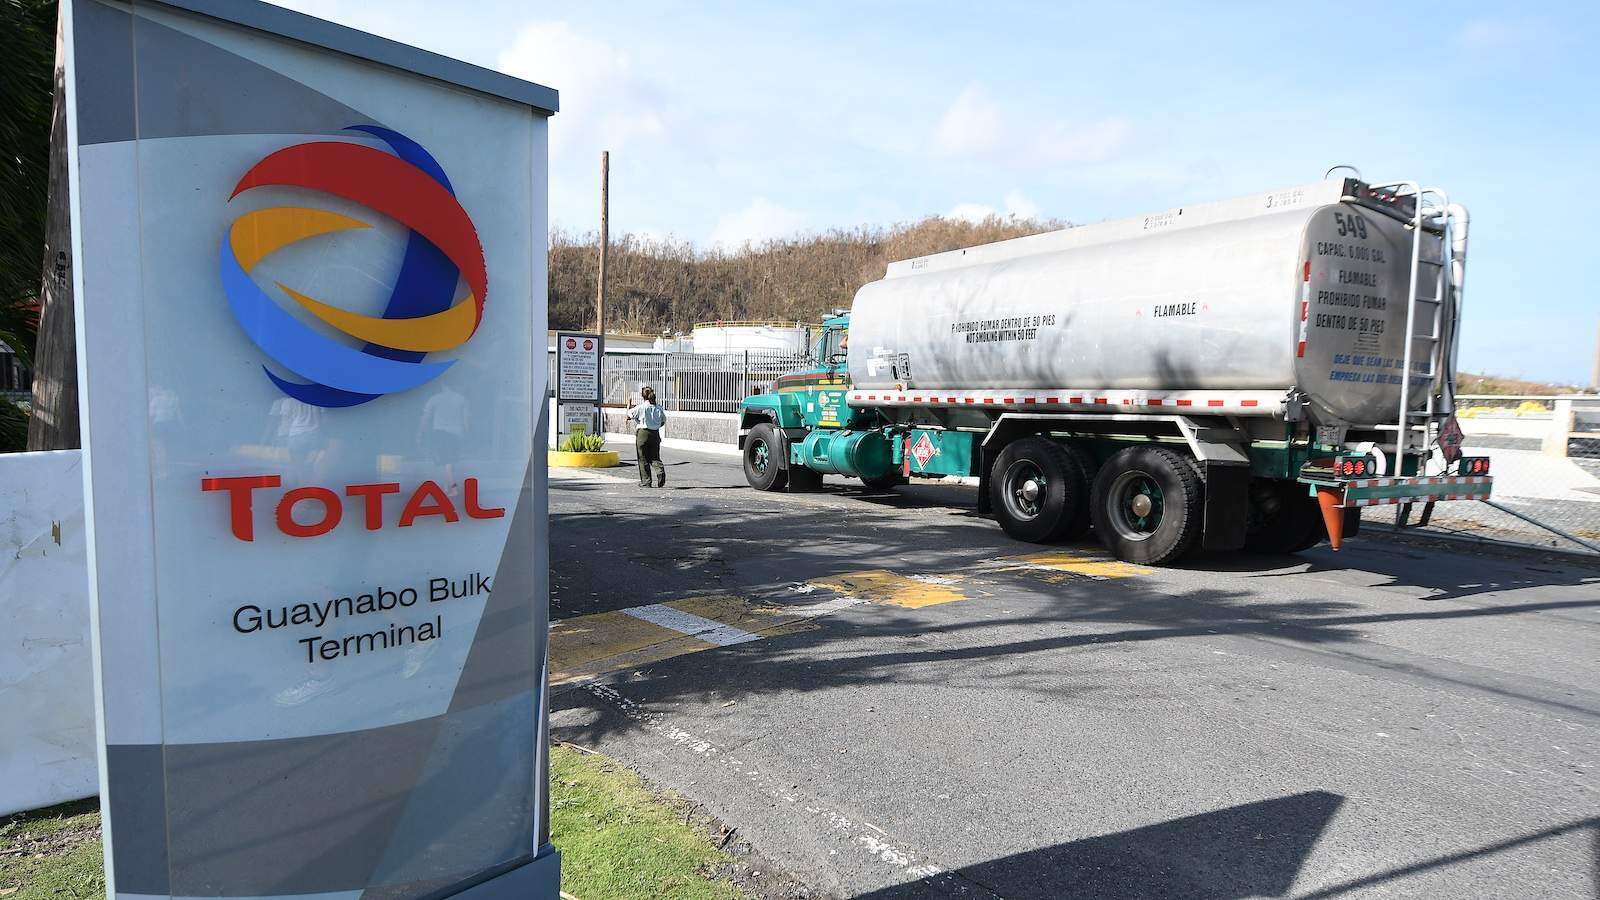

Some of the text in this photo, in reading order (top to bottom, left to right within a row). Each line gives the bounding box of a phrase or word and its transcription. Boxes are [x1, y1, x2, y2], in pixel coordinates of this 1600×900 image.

[1334, 212, 1368, 240] 549
[1338, 270, 1376, 287] FLAMABLE
[1154, 302, 1196, 318] FLAMABLE
[1317, 291, 1386, 311] PROHIBIDO FUMAR
[980, 319, 1000, 331] FUMAR
[1001, 317, 1022, 329] DENTRO
[1023, 316, 1031, 328] DE
[1032, 315, 1041, 327] 50
[1042, 314, 1056, 326] PIES
[1316, 313, 1385, 333] DENTRO DE 50 PIES
[966, 328, 1037, 344] NOT SMOKING WITHIN 50 FEET
[202, 475, 505, 541] TOTAL
[233, 572, 492, 633] Guaynabo Bulk
[298, 615, 442, 664] Terminal
